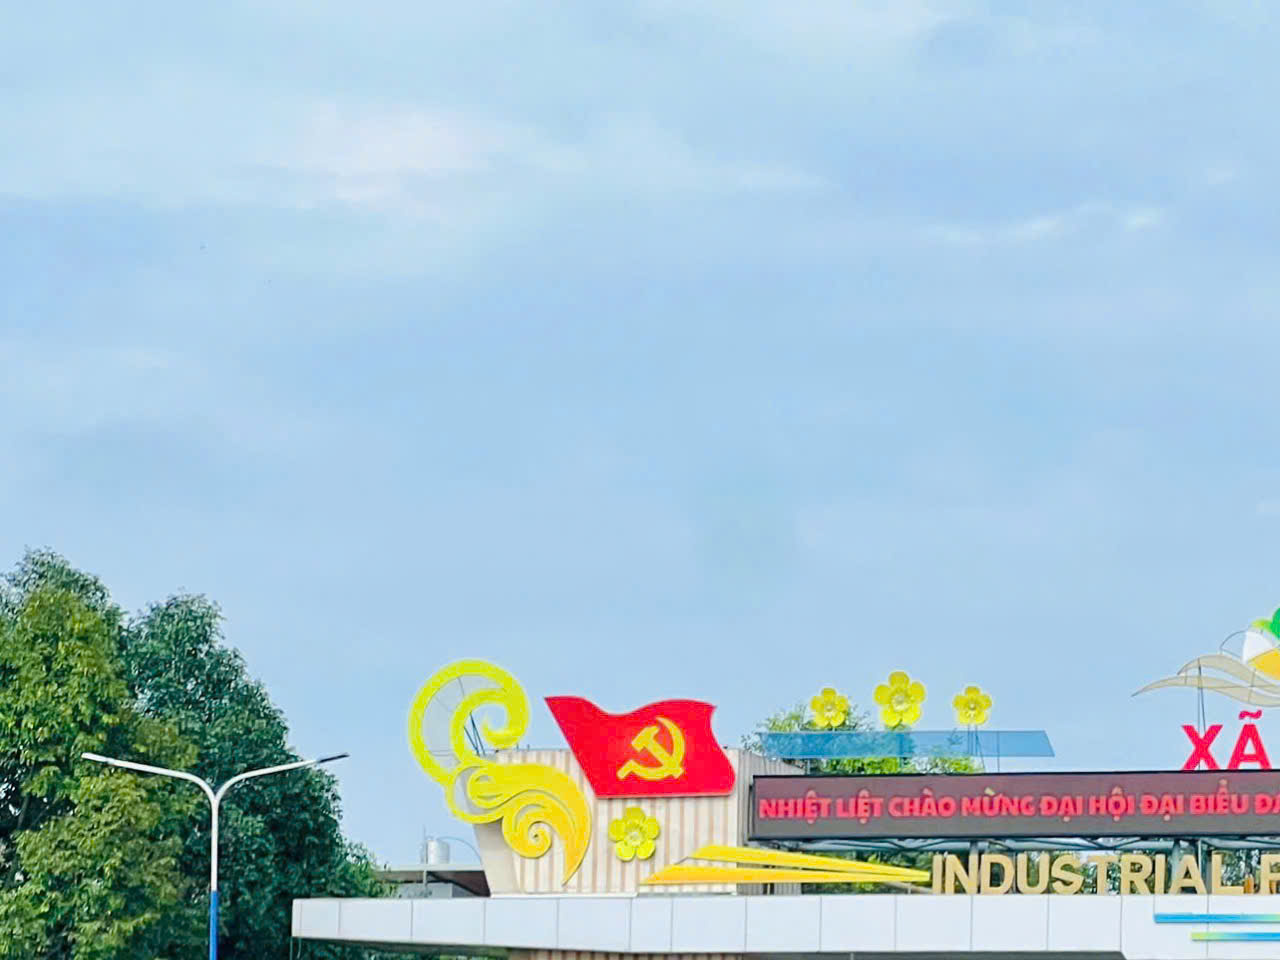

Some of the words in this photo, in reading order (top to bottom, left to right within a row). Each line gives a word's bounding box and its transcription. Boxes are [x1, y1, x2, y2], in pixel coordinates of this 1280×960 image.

[1181, 709, 1273, 770] XÃ
[759, 789, 832, 824] NHIỆT
[835, 788, 884, 824] LIỆT
[888, 787, 957, 818] CHÀO
[1040, 794, 1083, 823] ĐẠI
[1088, 786, 1135, 822] HỘI
[1140, 794, 1185, 822] ĐẠI
[1189, 778, 1249, 815] BIỂU
[932, 851, 1244, 895] INDUSTRIAL
